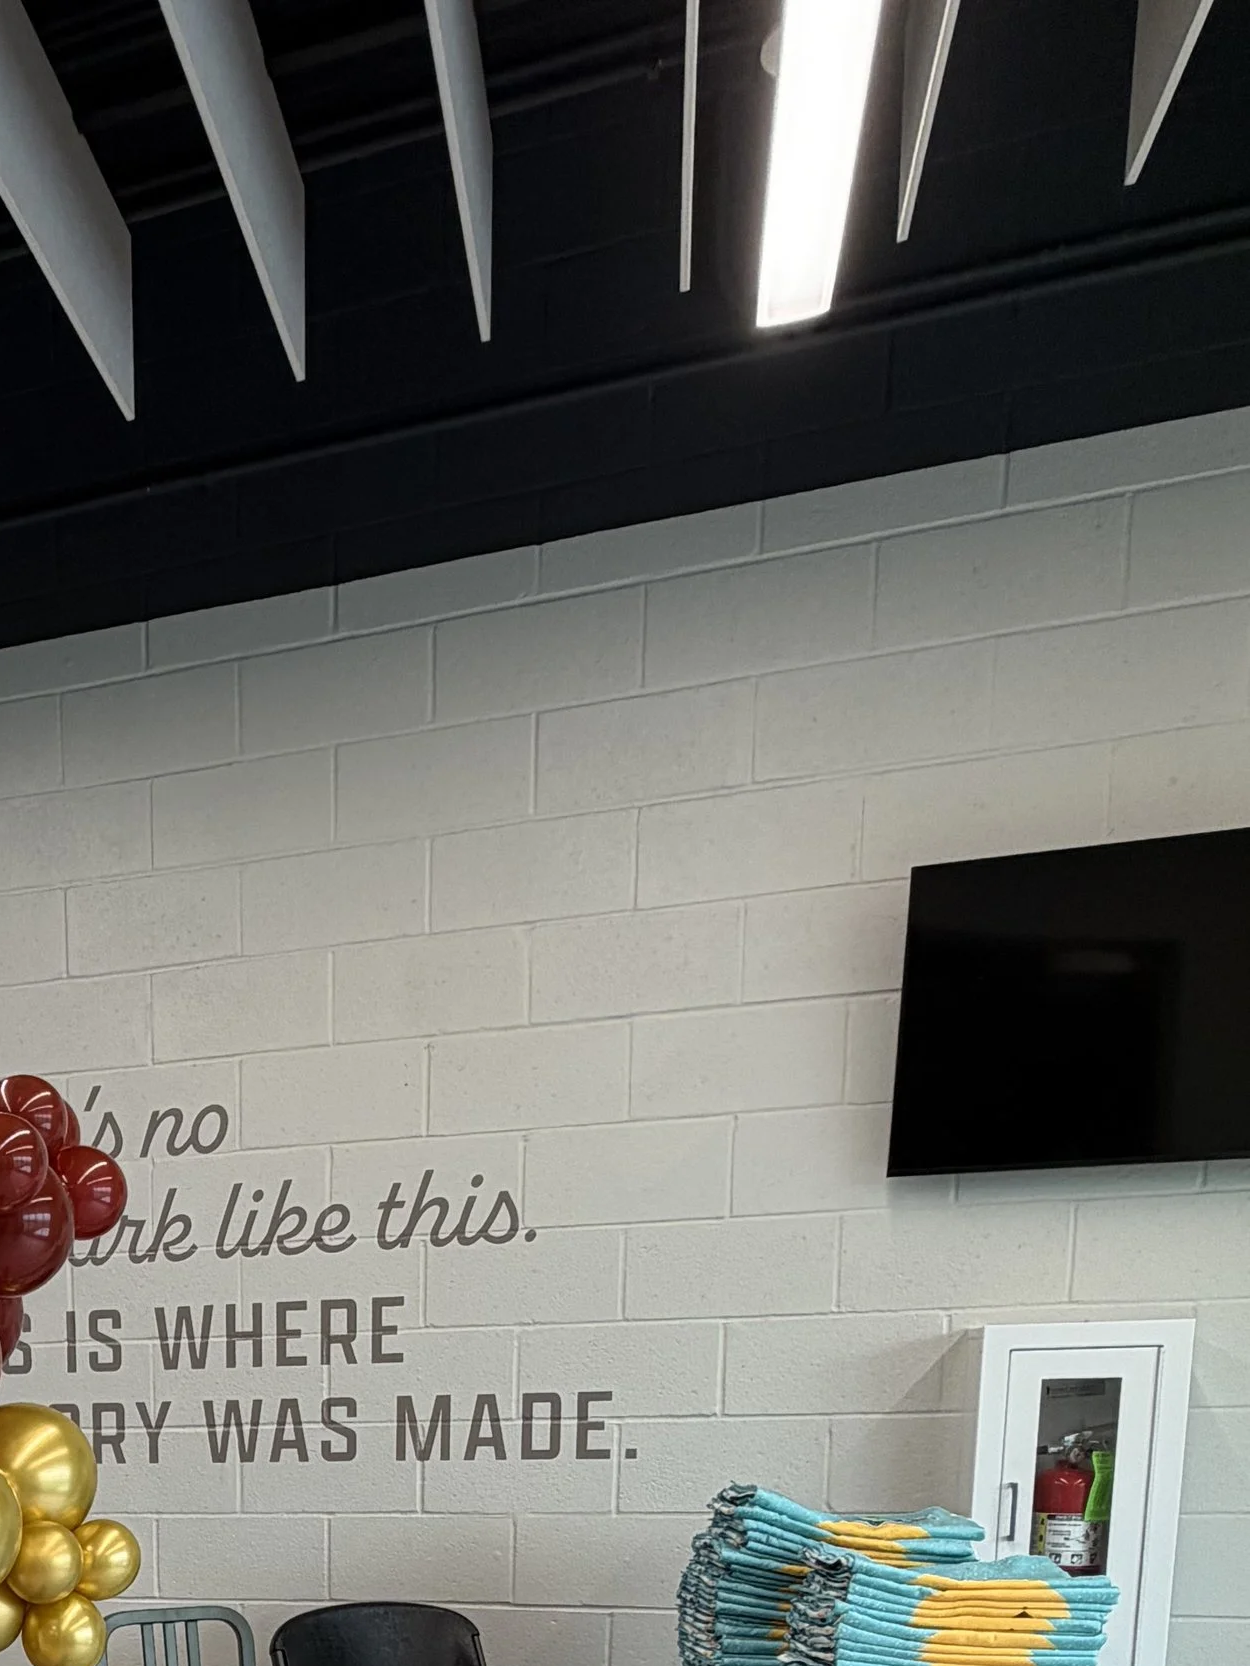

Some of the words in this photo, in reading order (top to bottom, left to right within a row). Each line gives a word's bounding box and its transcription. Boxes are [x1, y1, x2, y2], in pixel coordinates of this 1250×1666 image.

[140, 1104, 228, 1158] no
[216, 1179, 357, 1259] like
[376, 1169, 537, 1251] this.
[66, 1309, 122, 1373] IS
[153, 1296, 405, 1371] WHERE
[203, 1397, 358, 1463] WAS
[395, 1390, 638, 1462] MADE.
